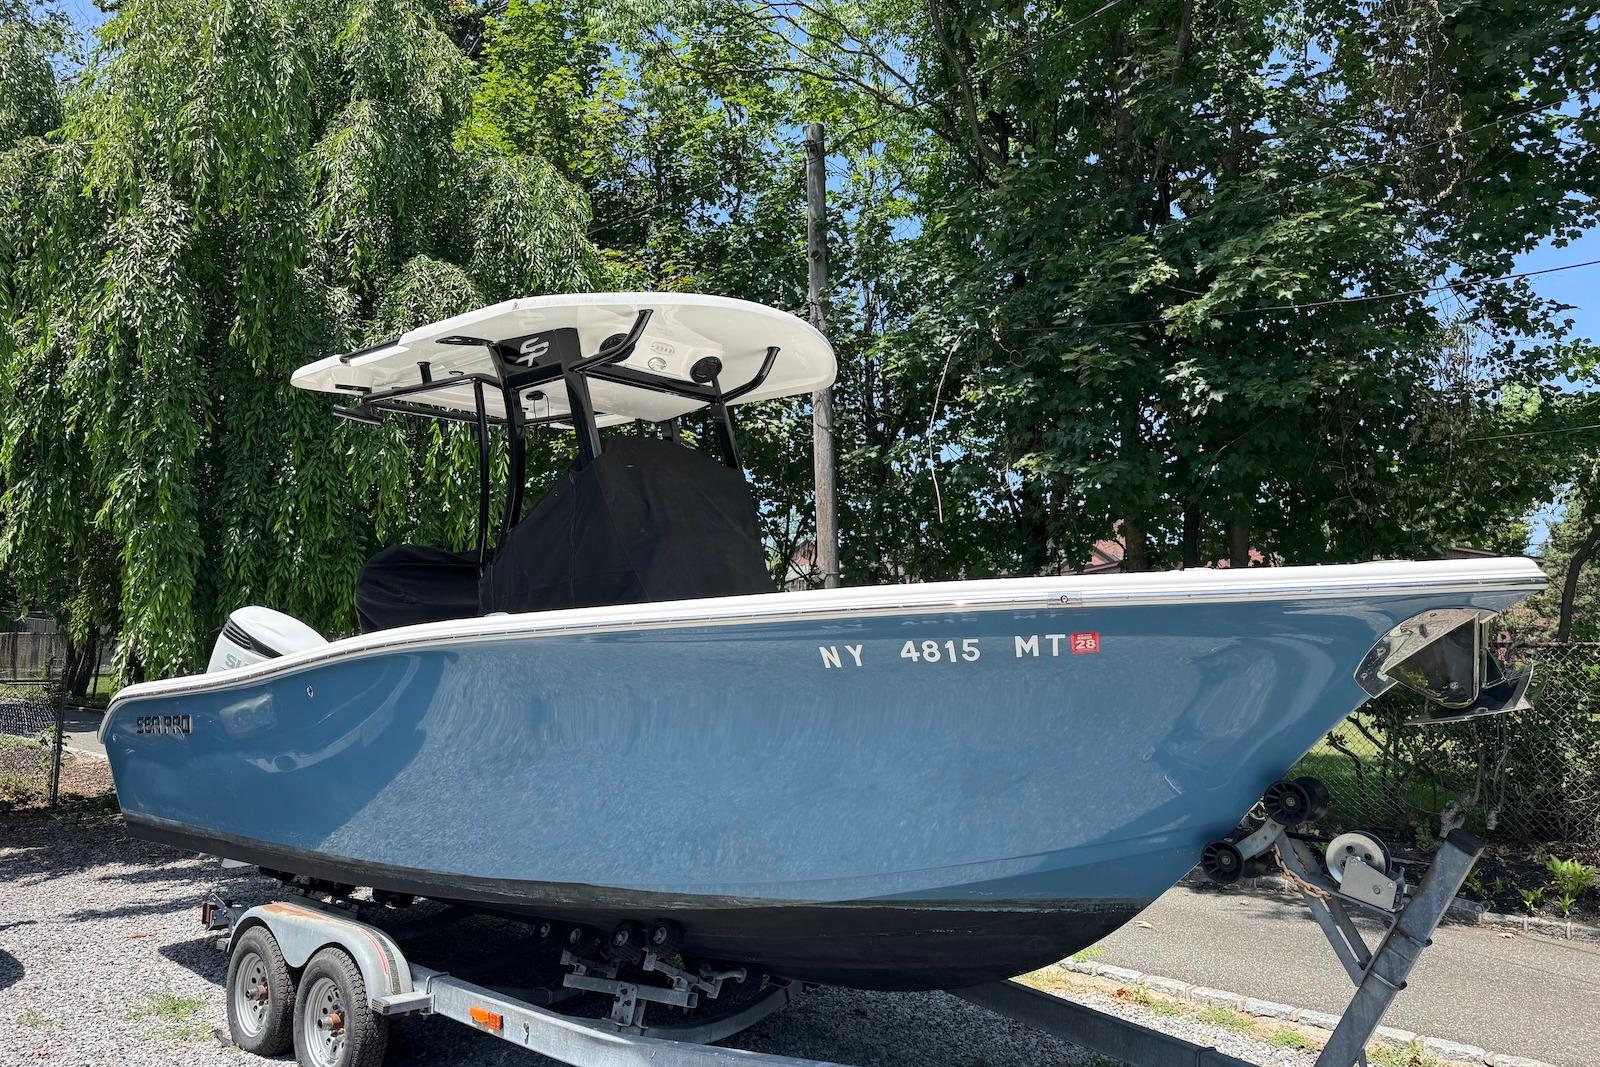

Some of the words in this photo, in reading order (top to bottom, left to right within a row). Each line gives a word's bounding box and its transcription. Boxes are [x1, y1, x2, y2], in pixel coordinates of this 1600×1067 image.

[819, 644, 863, 669] NY
[900, 638, 981, 663] 4815
[1014, 633, 1066, 658] MT
[1075, 639, 1096, 650] 28
[136, 716, 161, 734] SEA
[163, 714, 193, 738] PRO
